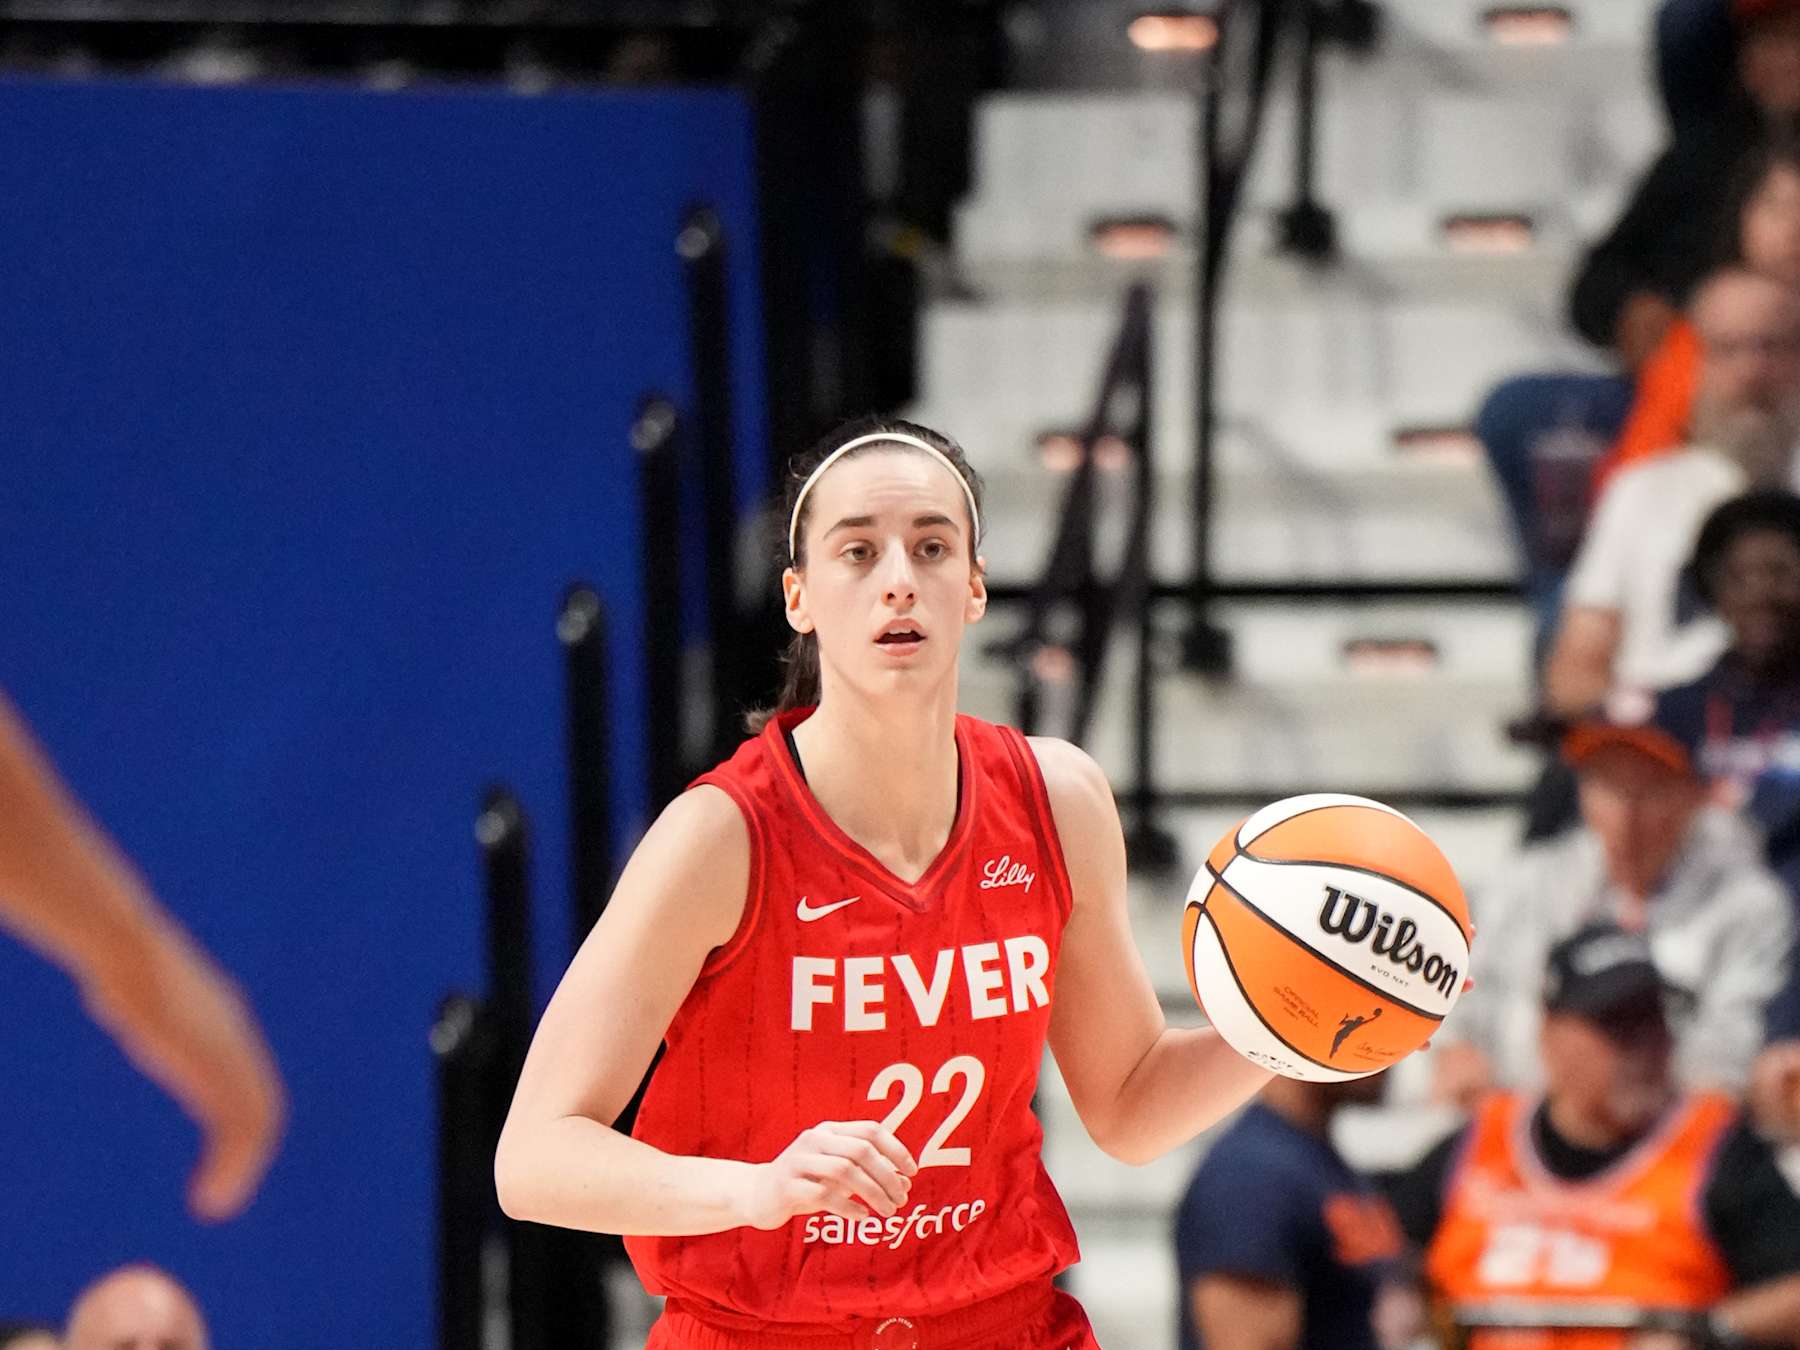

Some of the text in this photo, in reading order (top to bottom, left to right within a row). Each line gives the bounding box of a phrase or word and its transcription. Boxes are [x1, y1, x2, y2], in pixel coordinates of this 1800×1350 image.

[980, 855, 1035, 893] Lilly
[791, 935, 1050, 1032] FEVER
[1318, 886, 1458, 998] Wilson
[867, 1055, 985, 1169] 22
[803, 1199, 986, 1250] salesforce
